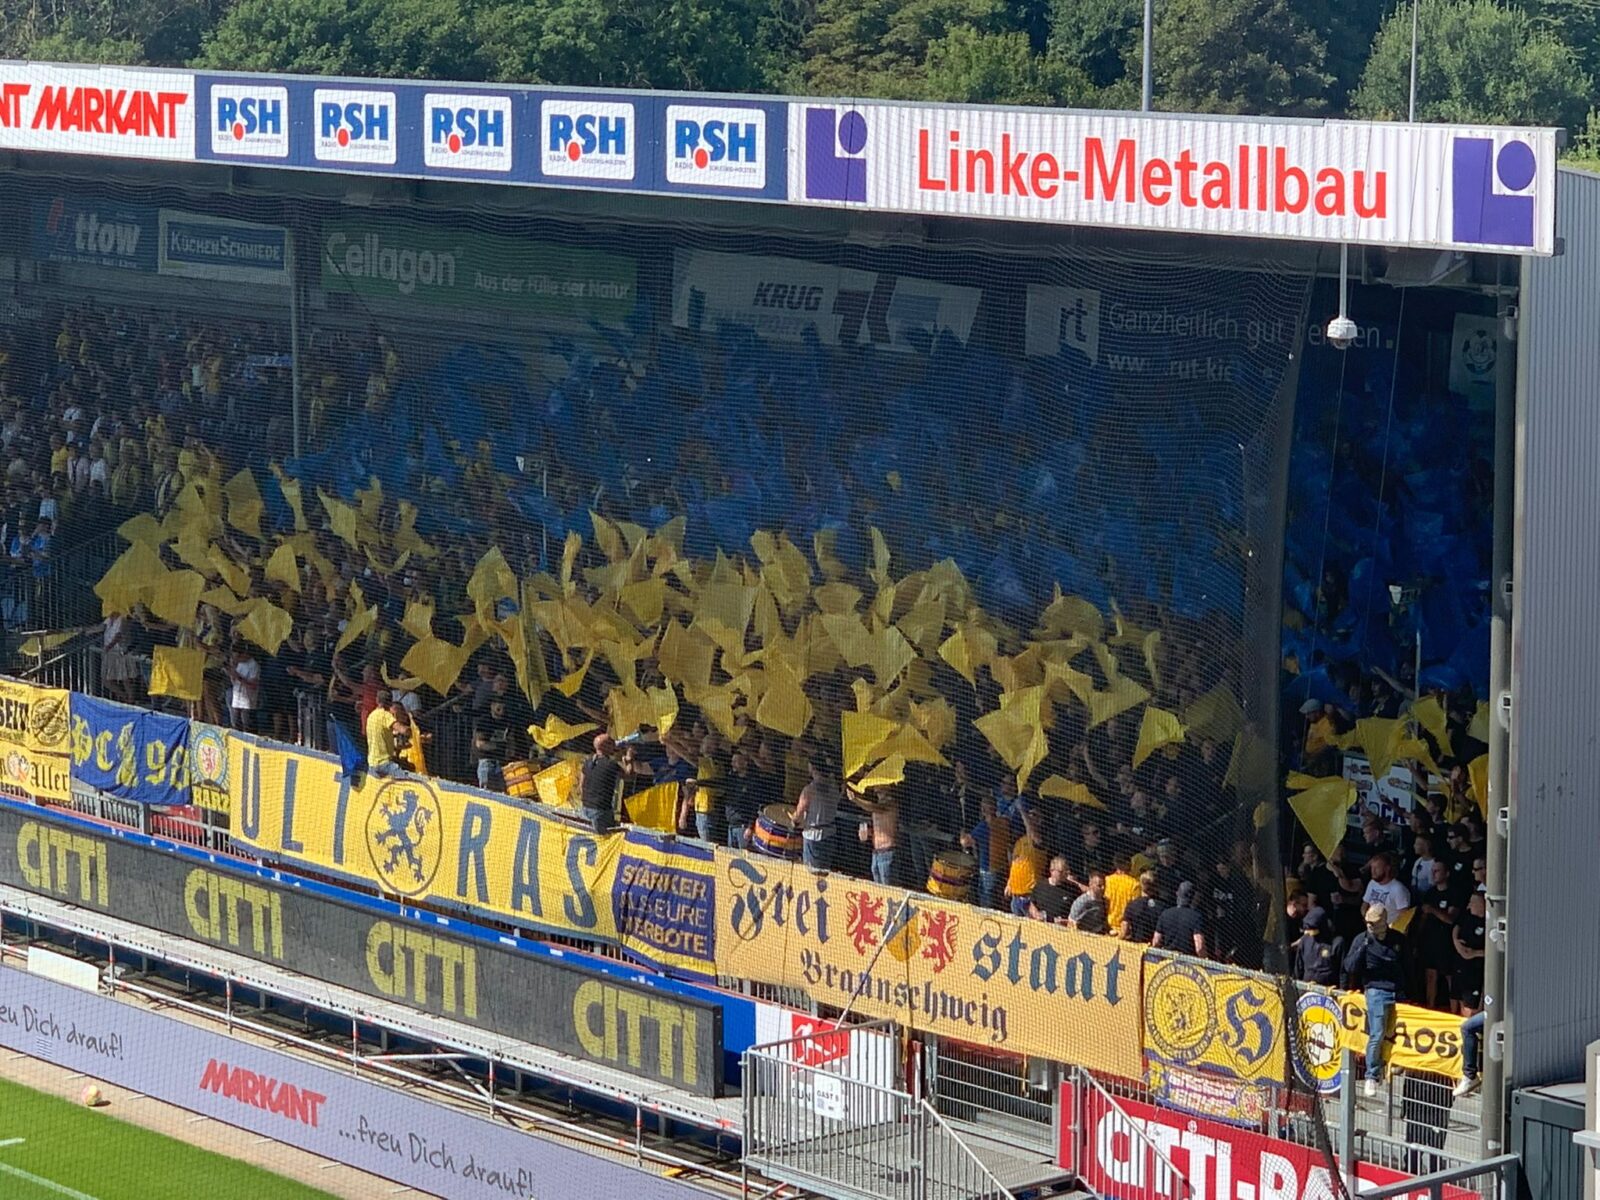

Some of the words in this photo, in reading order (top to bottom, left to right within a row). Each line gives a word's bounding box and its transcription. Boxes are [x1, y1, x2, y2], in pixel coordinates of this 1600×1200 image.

[31, 85, 188, 139] MARKANT
[218, 97, 281, 135] RSH
[321, 102, 389, 141] RSH
[432, 107, 504, 147] RSH
[549, 114, 626, 156] RSH
[675, 119, 757, 163] RSH
[675, 161, 694, 170] RADIO
[918, 128, 1387, 219] Linke-Metallbau
[474, 271, 498, 291] Aus
[502, 274, 524, 293] der
[752, 281, 823, 311] KRUG
[1109, 301, 1239, 340] Ganzheitlich
[17, 821, 109, 907] CITTI
[184, 867, 283, 960] CITTI
[655, 897, 707, 928] EURE
[365, 920, 478, 1019] CITTI
[800, 947, 1008, 1043] Braunschweig
[22, 1004, 61, 1040] Dich
[66, 1021, 124, 1061] drauf!
[572, 979, 697, 1086] CITTI
[1342, 1001, 1459, 1059] CAOS
[198, 1057, 328, 1128] MARKANT
[408, 1132, 456, 1174] Dich
